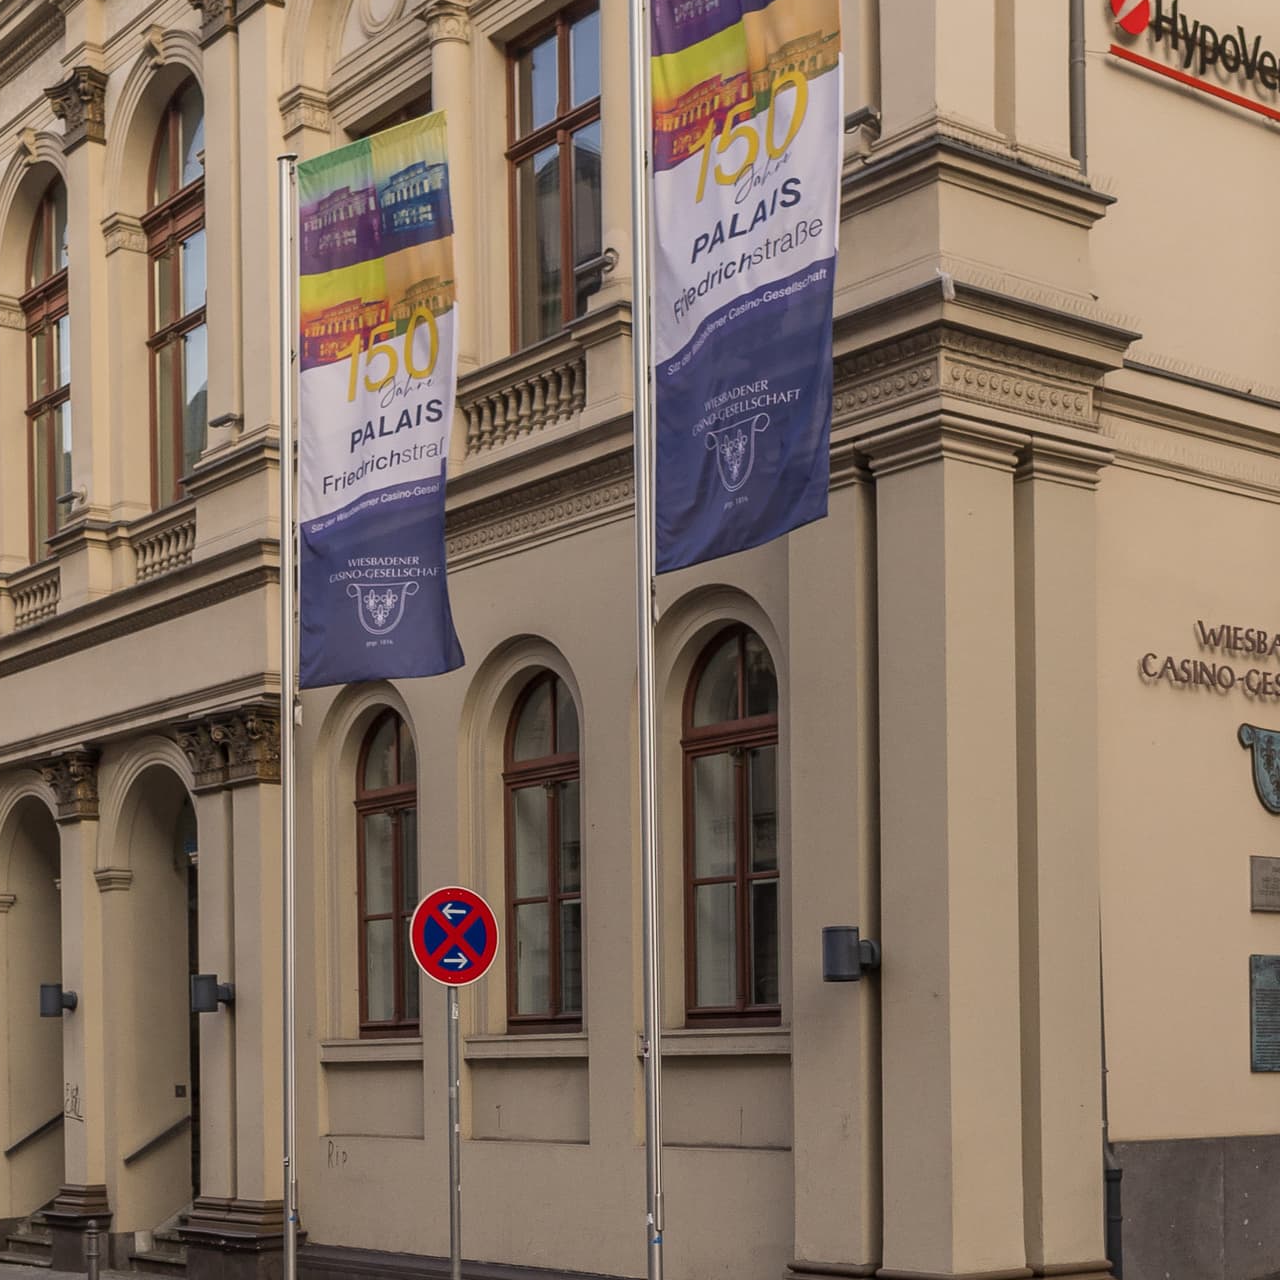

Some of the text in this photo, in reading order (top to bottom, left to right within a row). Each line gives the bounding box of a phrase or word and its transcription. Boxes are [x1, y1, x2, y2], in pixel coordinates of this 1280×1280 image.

[688, 71, 809, 204] 150
[734, 151, 790, 205] Jahre
[690, 177, 802, 265] PALAIS
[673, 217, 824, 325] Friedrichstraße
[728, 267, 827, 321] Casino-Gesellschaft
[336, 306, 440, 403] 150
[378, 372, 434, 409] Jahre
[703, 379, 769, 412] WIESBADENER
[349, 399, 443, 454] PALAIS
[347, 555, 420, 567] WIESBADENER
